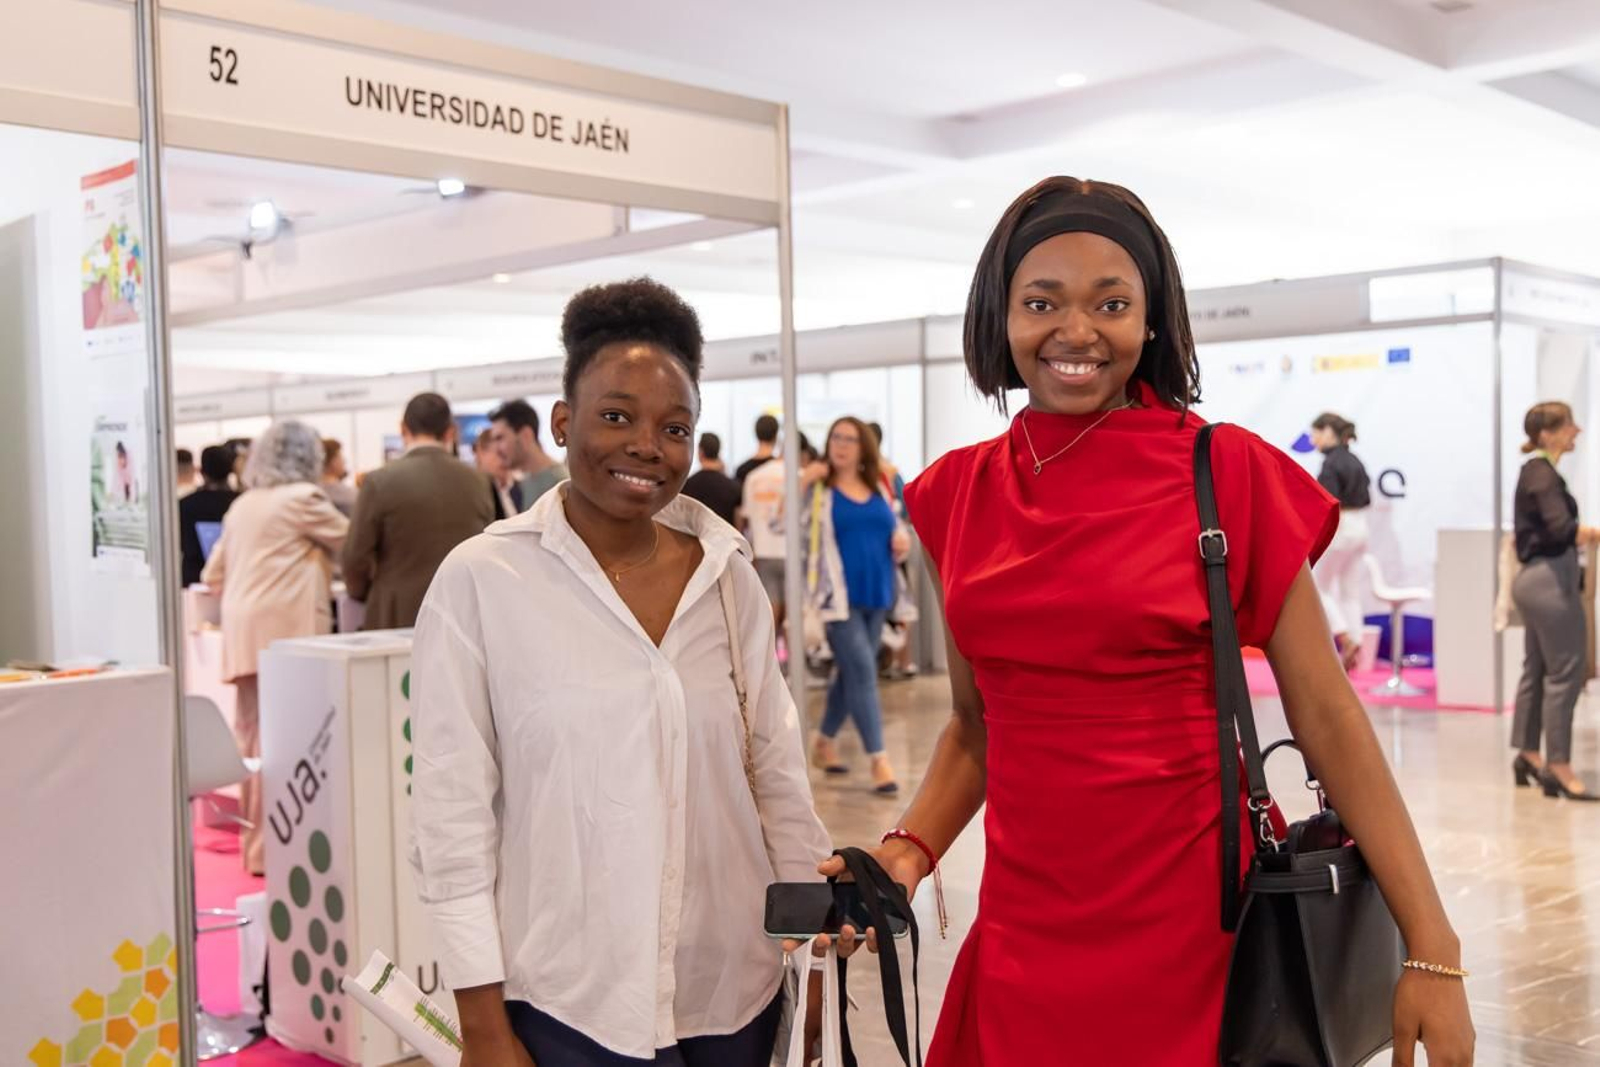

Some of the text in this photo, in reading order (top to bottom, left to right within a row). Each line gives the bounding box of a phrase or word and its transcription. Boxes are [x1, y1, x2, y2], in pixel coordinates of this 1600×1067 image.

[210, 45, 239, 85] 52
[345, 76, 630, 153] UNIVERSIDAD DE JAÉN
